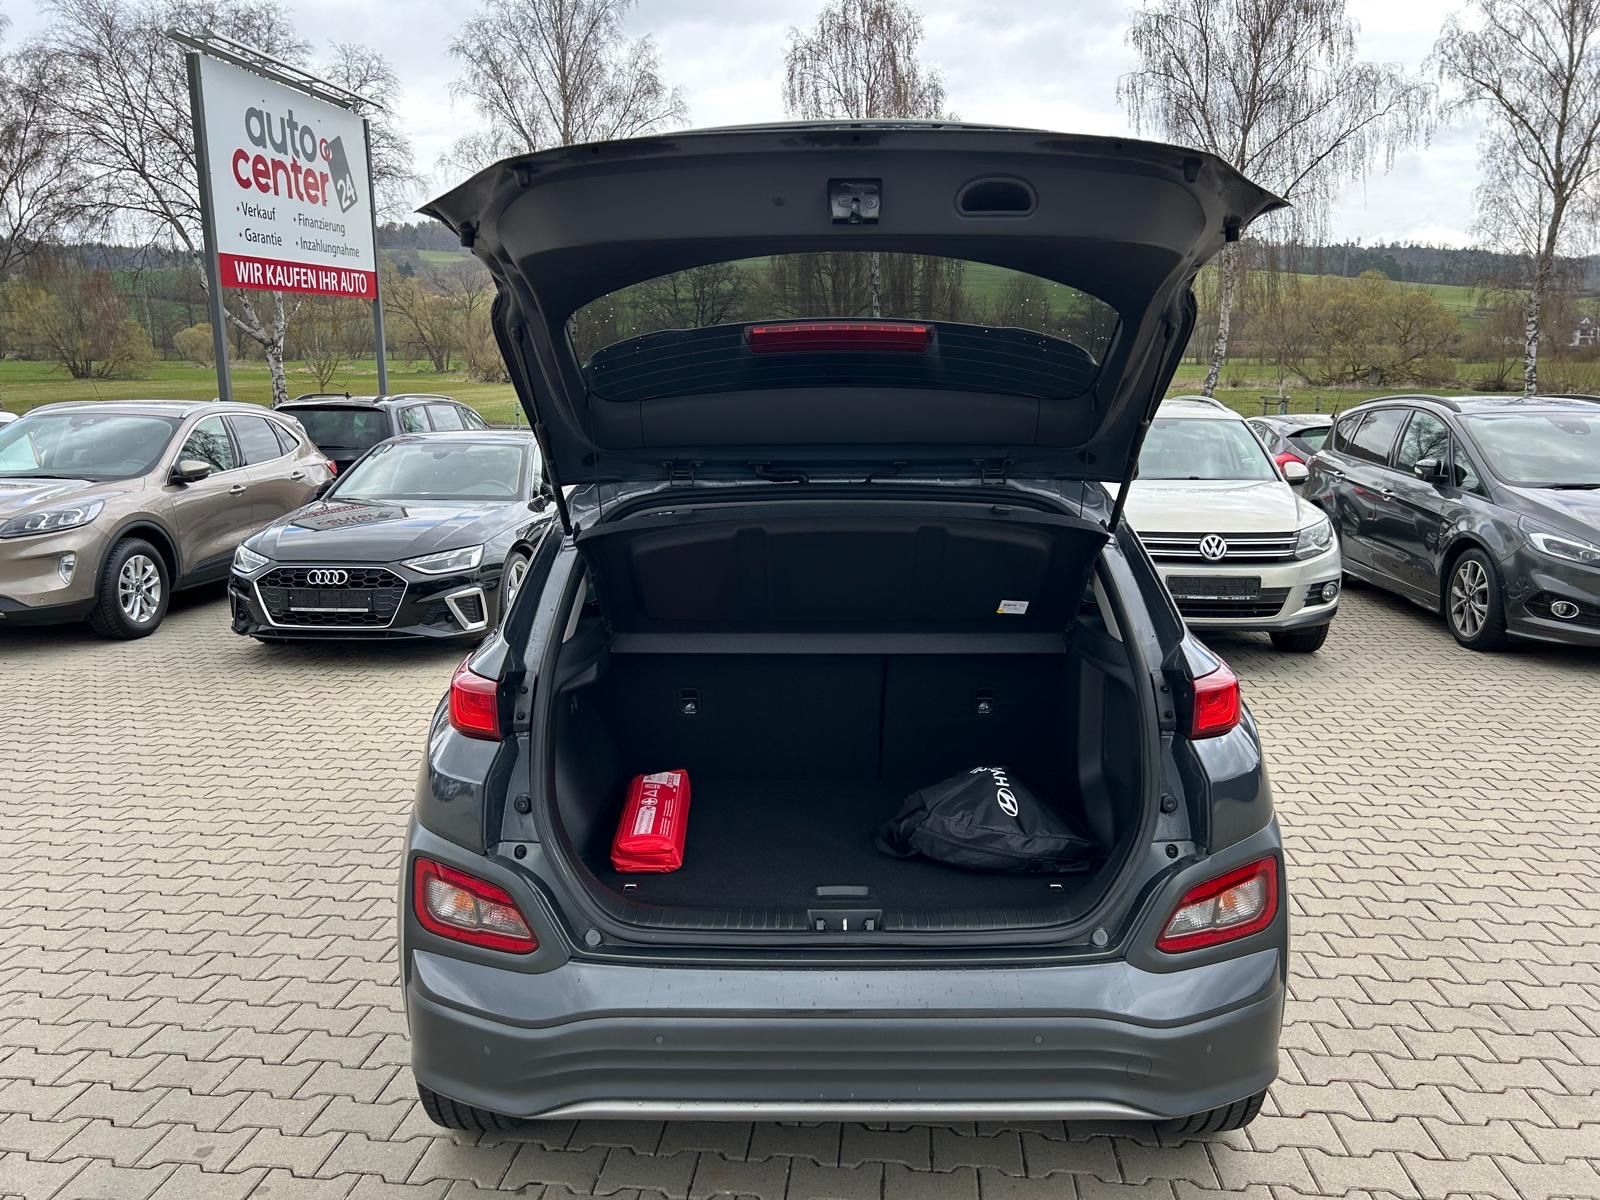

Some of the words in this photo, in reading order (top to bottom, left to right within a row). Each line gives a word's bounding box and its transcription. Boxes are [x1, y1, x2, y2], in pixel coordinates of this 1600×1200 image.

[245, 106, 317, 162] auto
[233, 148, 329, 207] center
[337, 173, 356, 206] 24
[241, 201, 276, 221] Verkauf
[298, 212, 345, 237] Finanzierung
[244, 227, 282, 246] Garantie
[300, 236, 360, 258] Inzahlungnahme
[234, 260, 264, 285] WIR
[265, 264, 317, 289] KAUFEN
[318, 270, 339, 292] IHR
[340, 271, 367, 294] AUTO
